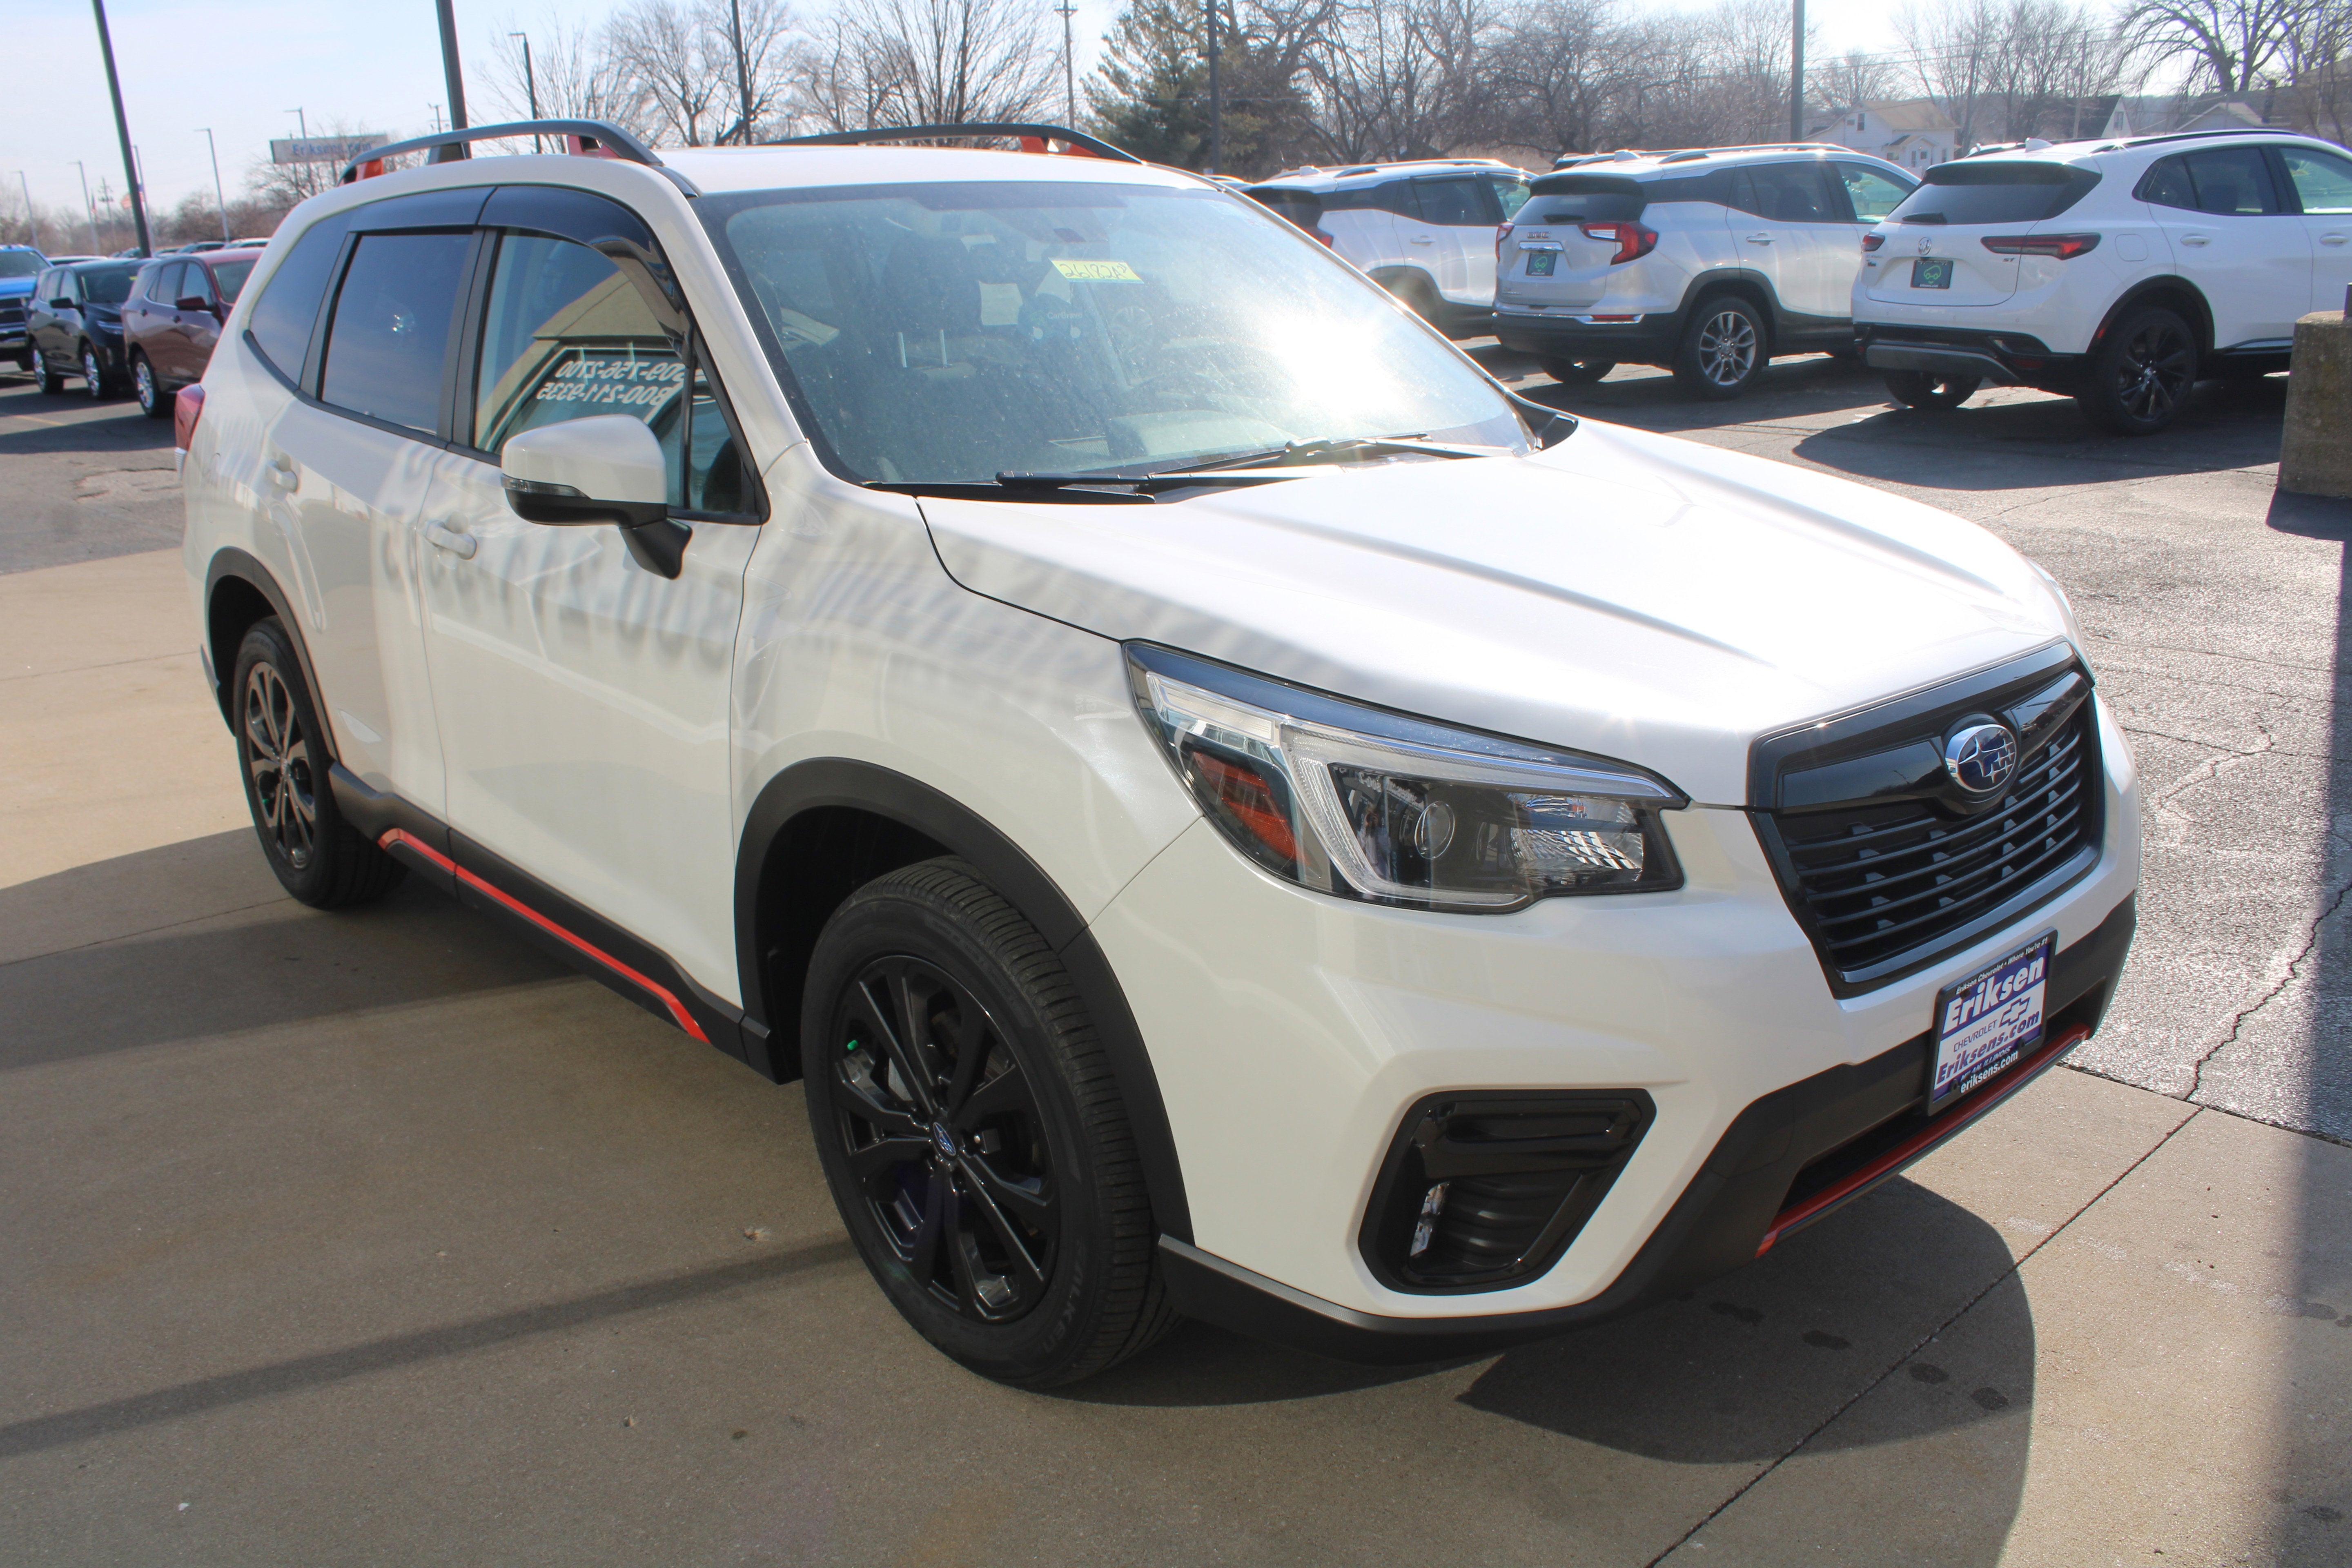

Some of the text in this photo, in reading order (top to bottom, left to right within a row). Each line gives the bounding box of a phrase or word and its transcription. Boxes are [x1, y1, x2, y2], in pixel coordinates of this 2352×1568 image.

[1956, 979, 1977, 995] Eriksen
[1978, 962, 2003, 982] Chevrolet
[2008, 952, 2024, 965] Where
[2041, 937, 2048, 946] #1
[1942, 957, 2044, 1034] Eriksen
[1936, 1010, 2040, 1085] Eriksens.com
[1953, 1019, 1998, 1052] CHEVROLET
[1960, 1050, 2018, 1093] eriksens.com
